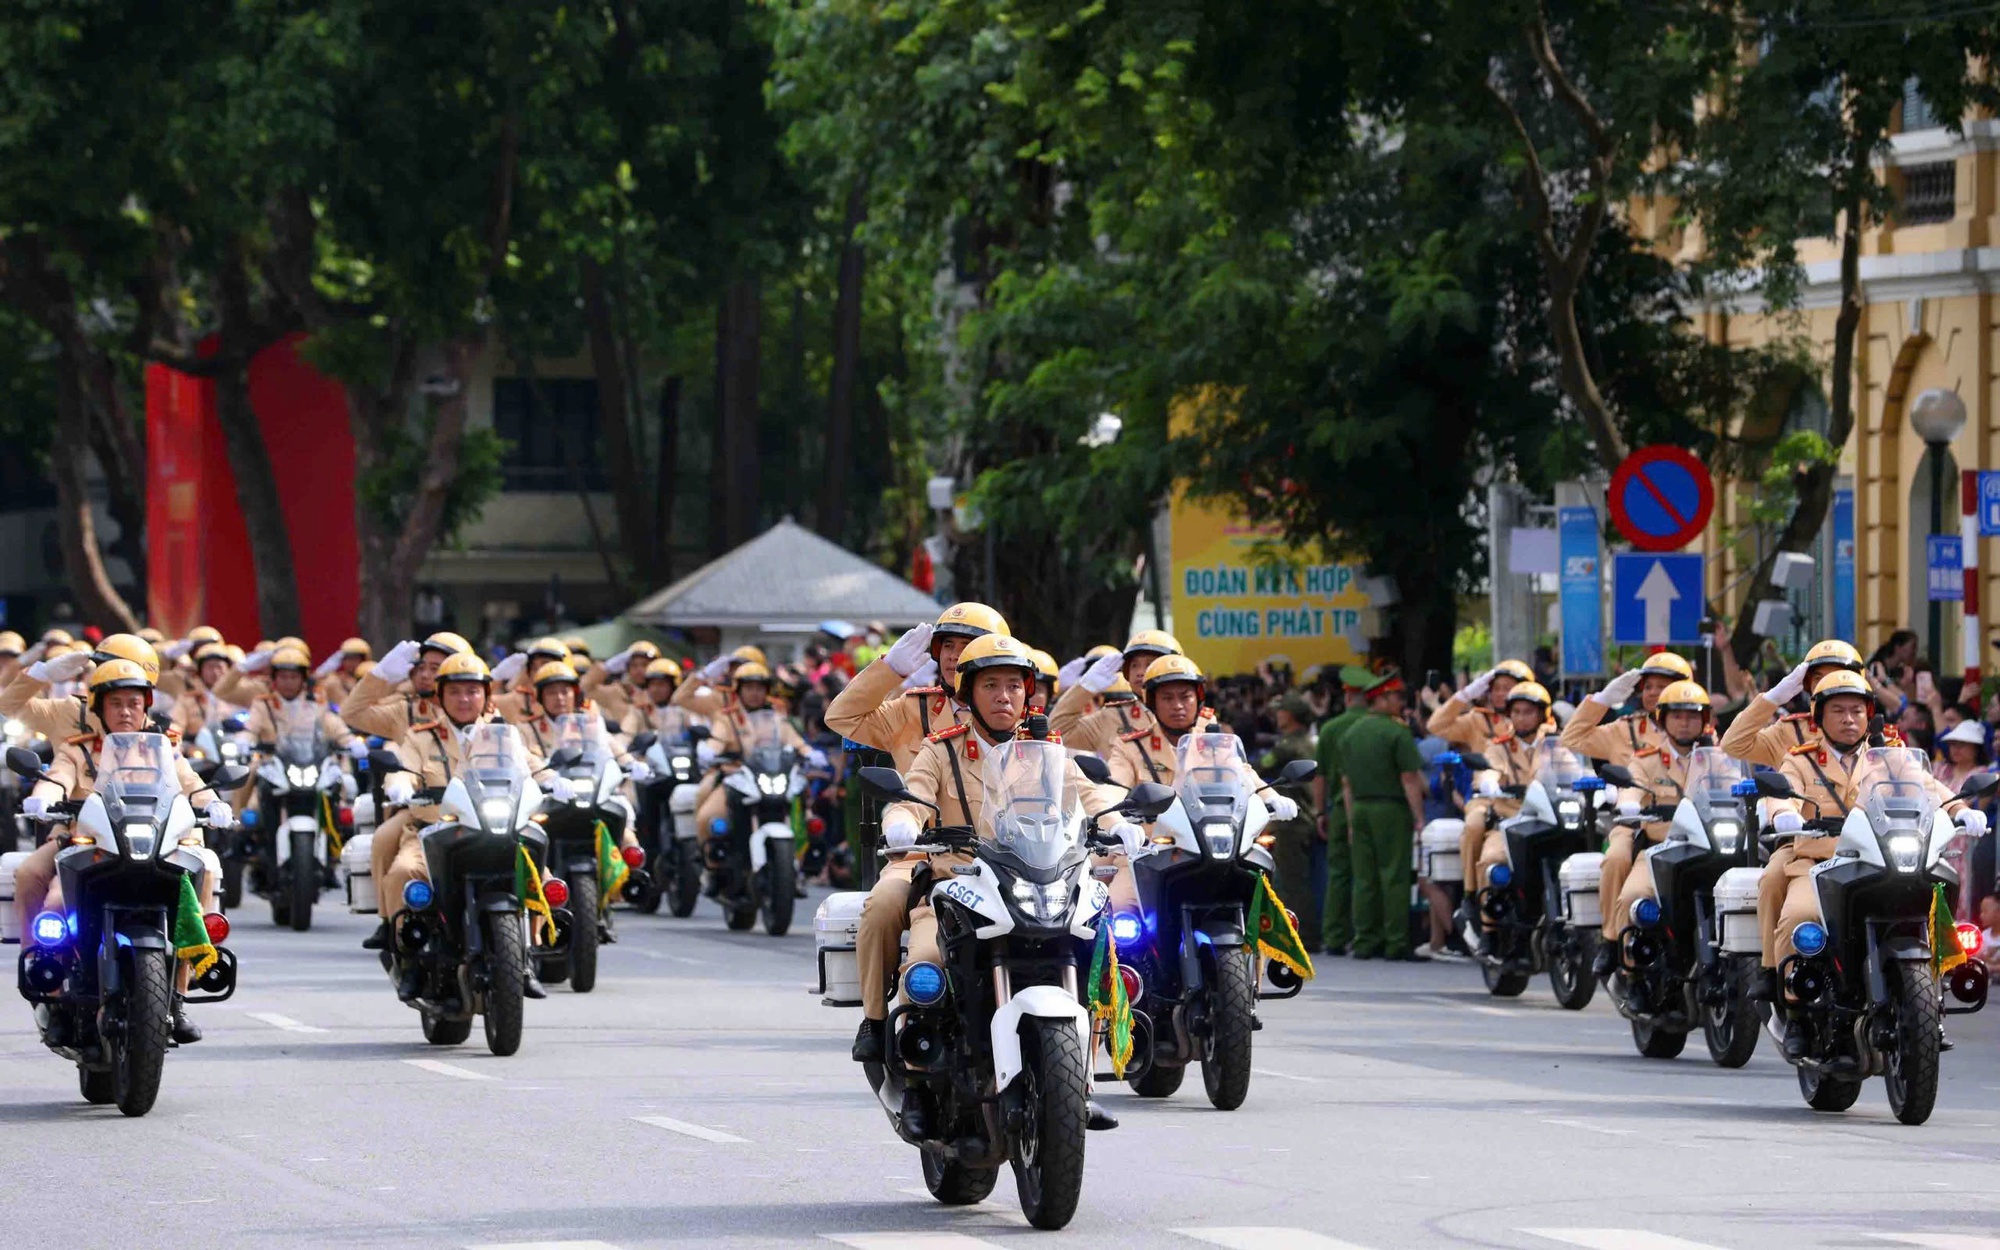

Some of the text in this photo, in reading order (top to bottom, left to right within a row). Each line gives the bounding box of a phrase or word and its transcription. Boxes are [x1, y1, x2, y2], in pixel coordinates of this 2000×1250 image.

[1185, 563, 1247, 595] ĐOÀN
[1198, 604, 1260, 637] CÙNG
[1266, 602, 1324, 636] PHÁT
[946, 881, 985, 909] CSGT
